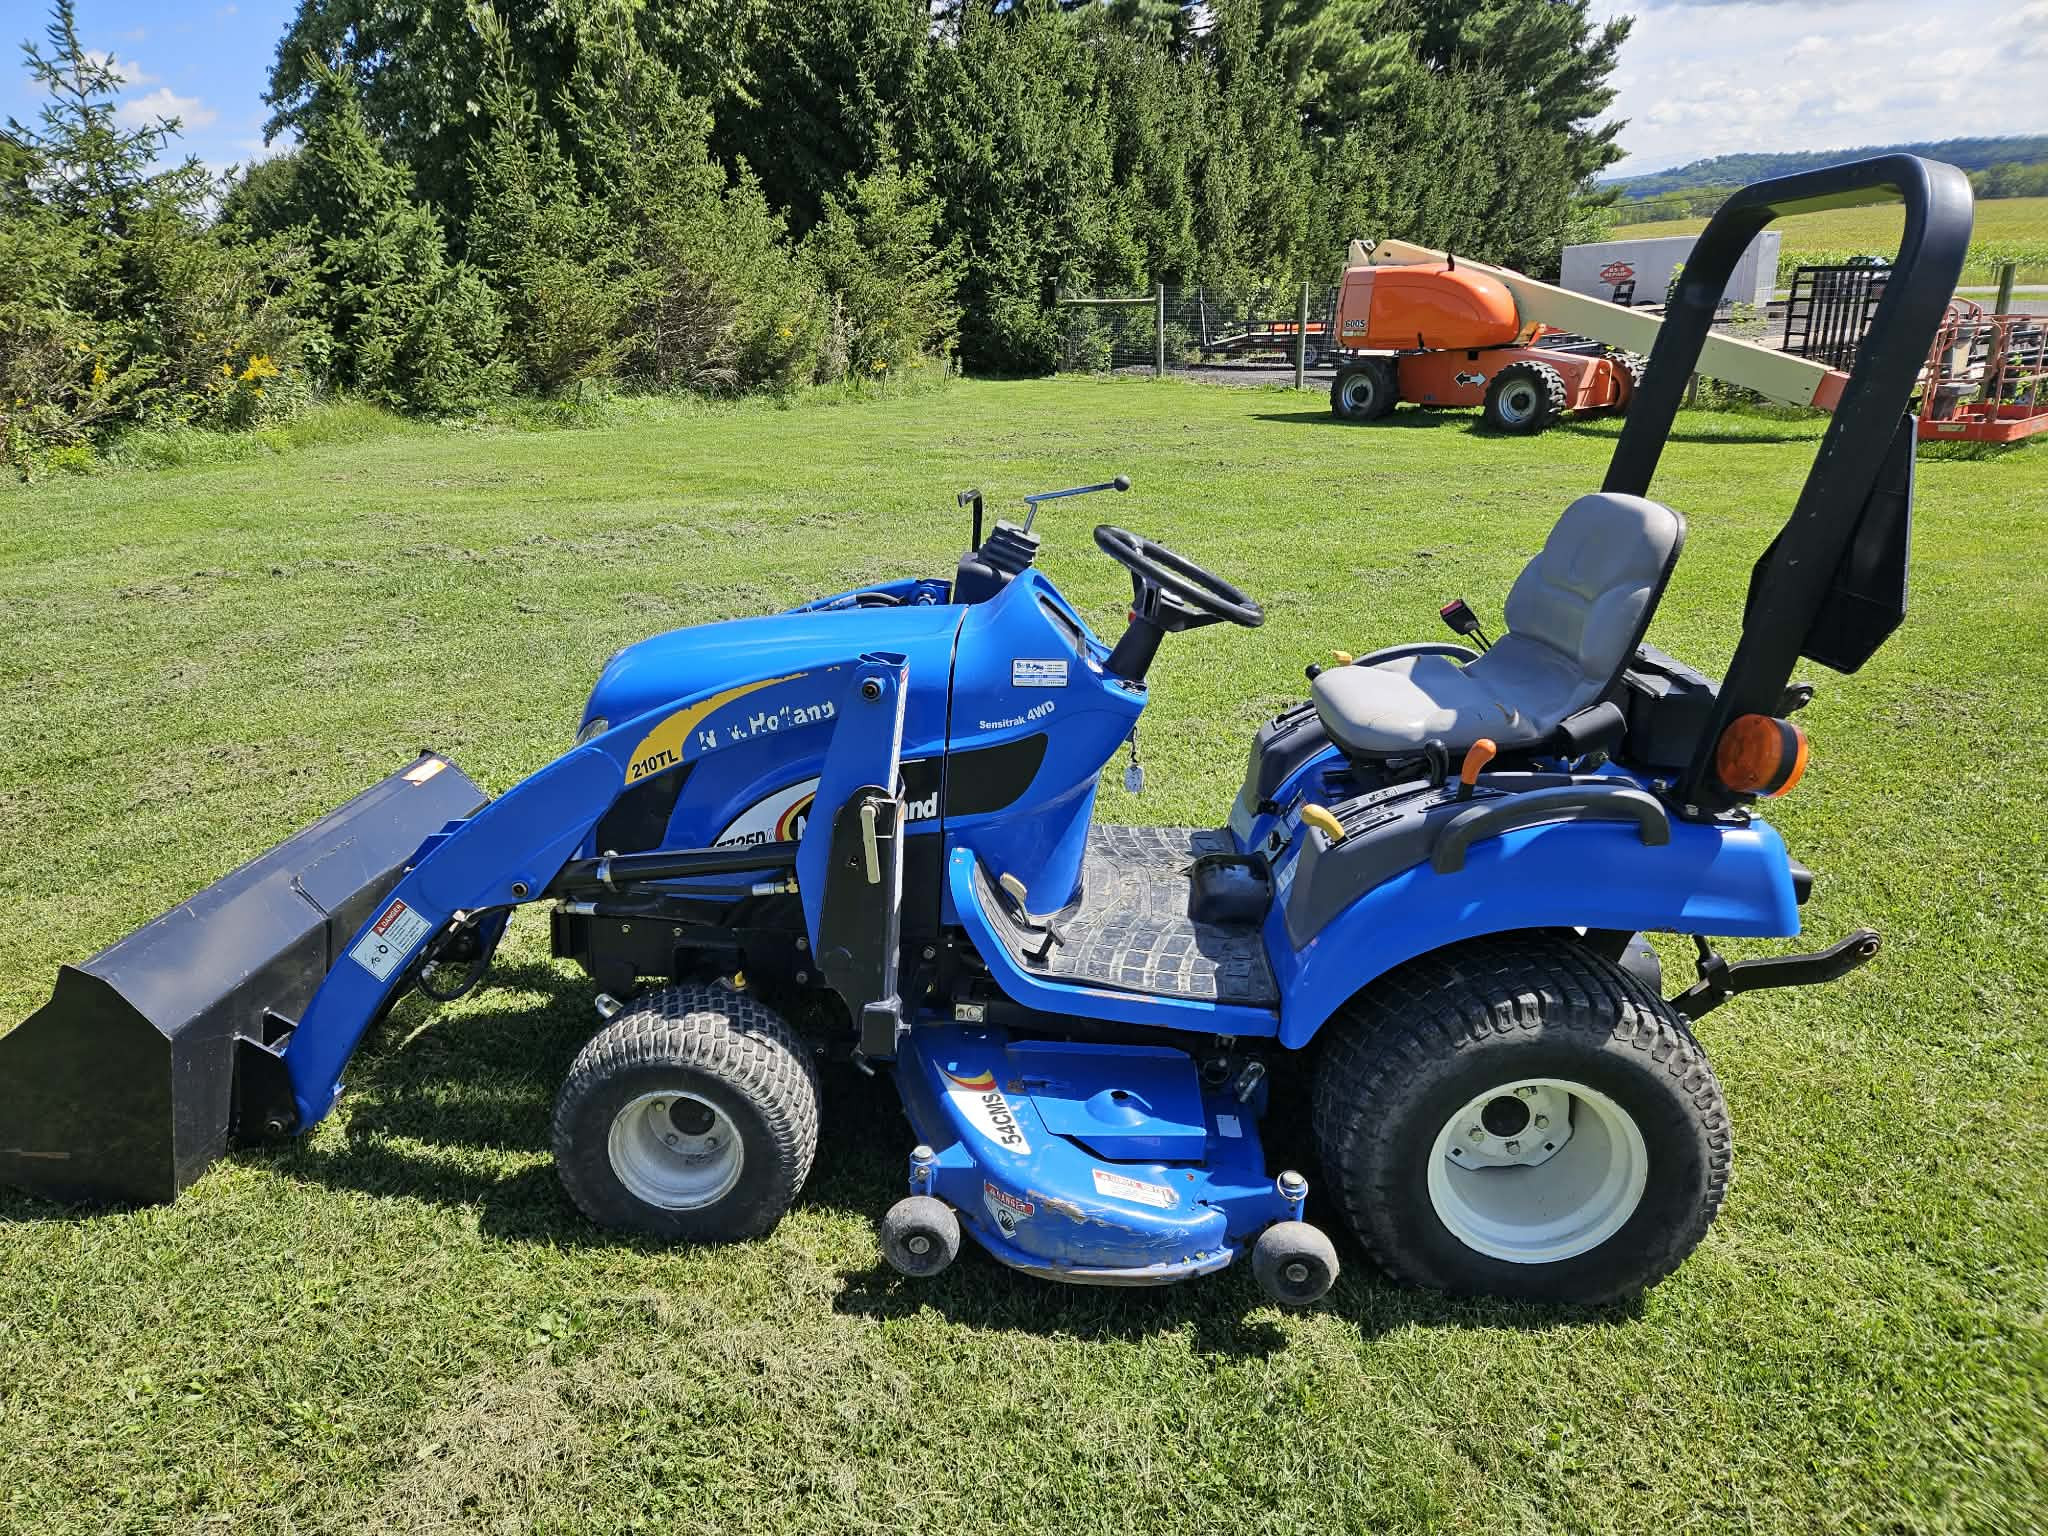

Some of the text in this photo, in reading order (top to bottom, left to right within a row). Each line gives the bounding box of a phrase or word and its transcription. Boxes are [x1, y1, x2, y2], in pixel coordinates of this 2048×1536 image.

[1345, 319, 1366, 328] 600S
[979, 700, 1056, 729] Sensitrak 4WD
[632, 749, 678, 779] 210TL
[982, 1093, 1023, 1145] 54CMS
